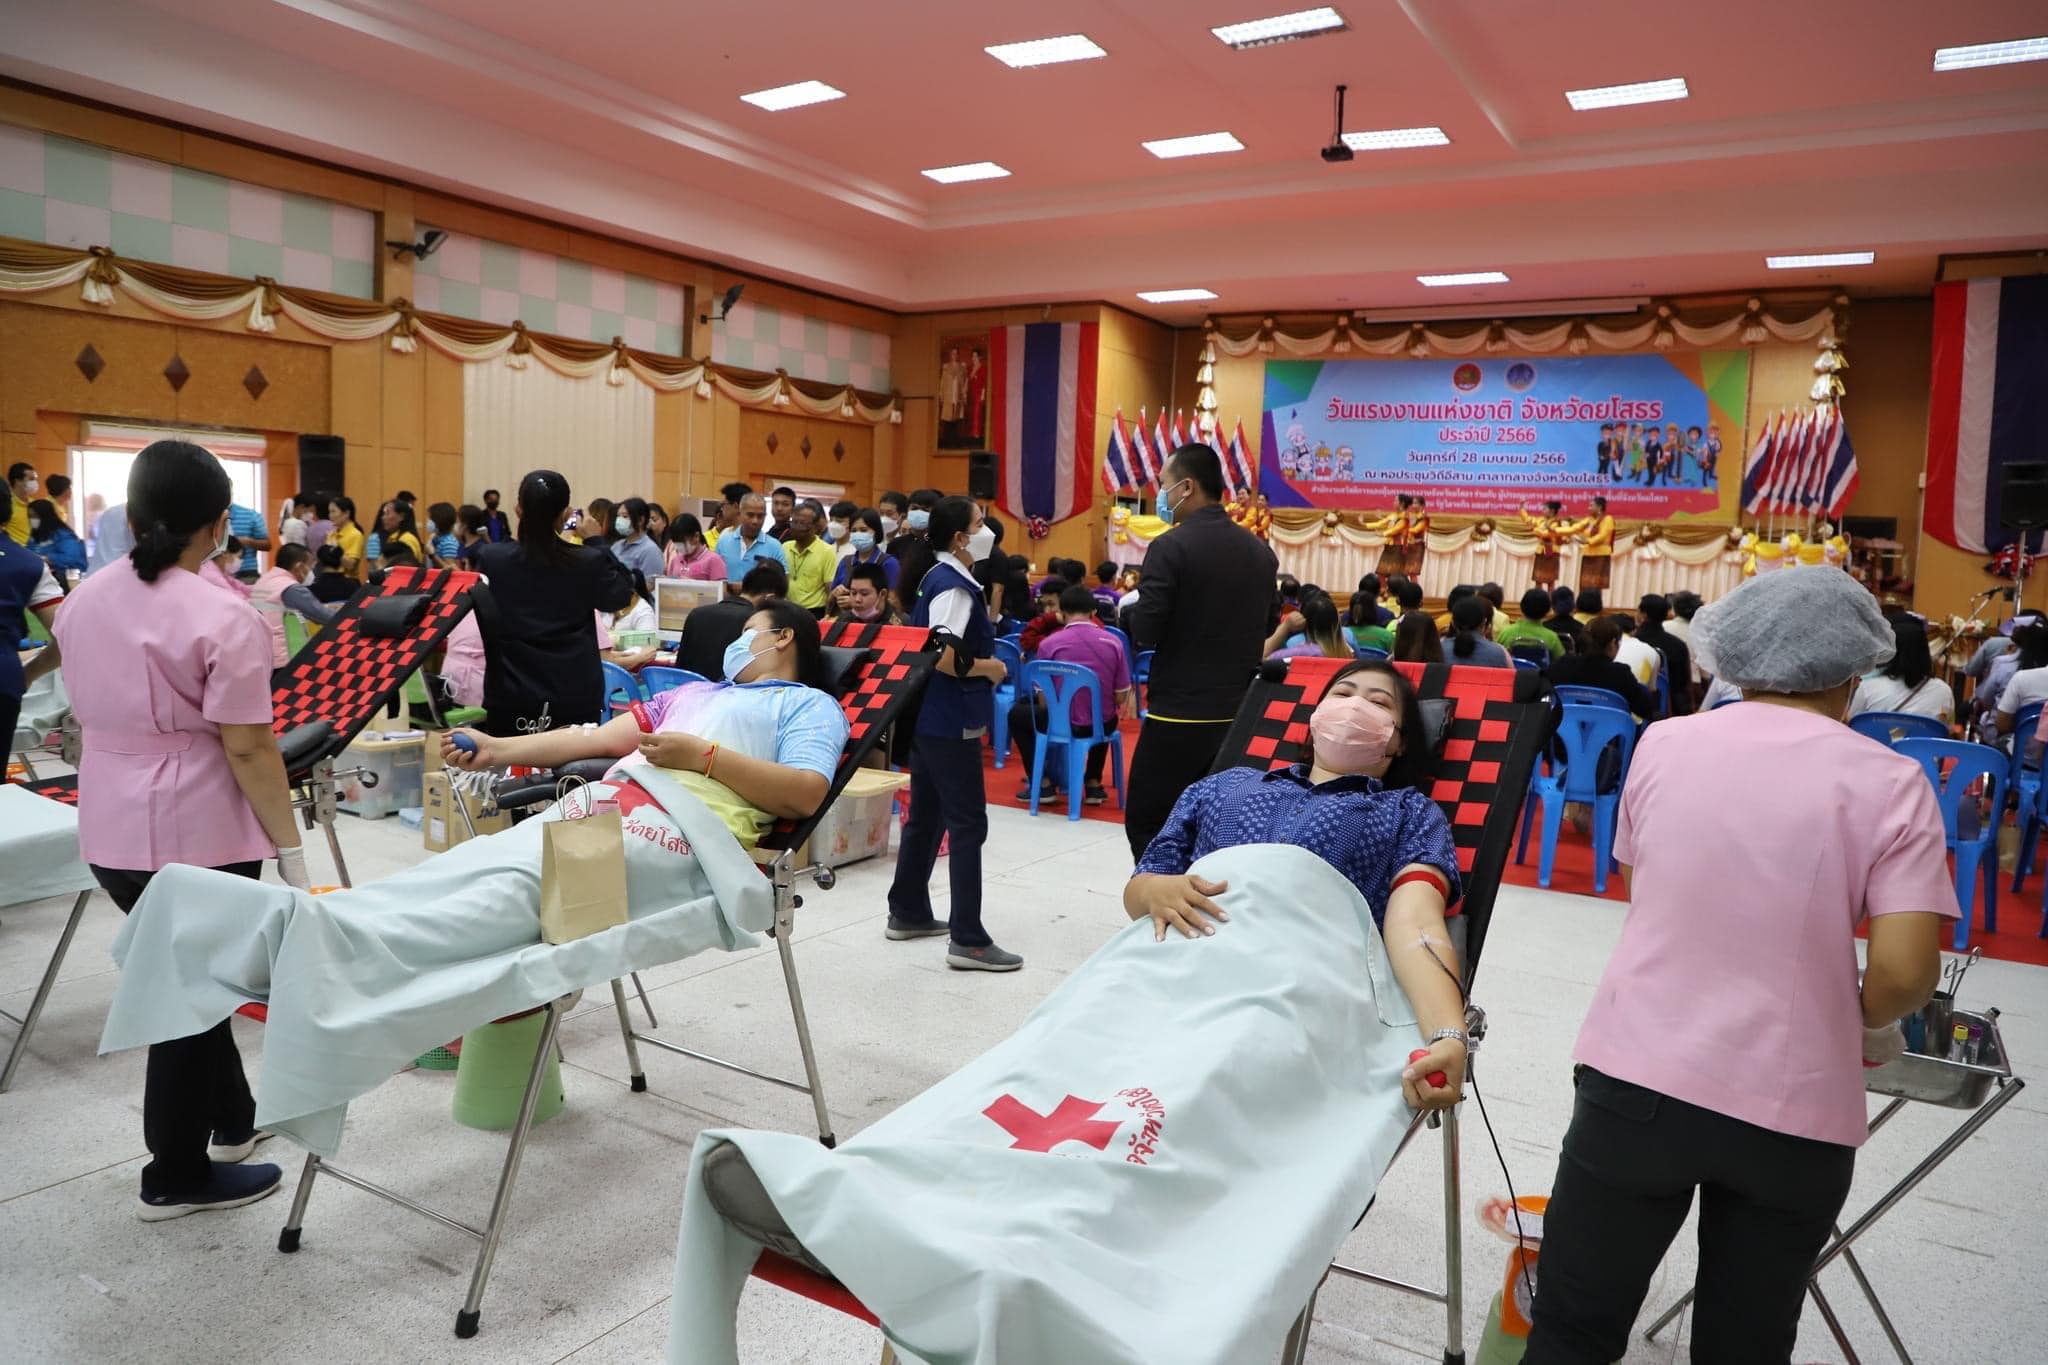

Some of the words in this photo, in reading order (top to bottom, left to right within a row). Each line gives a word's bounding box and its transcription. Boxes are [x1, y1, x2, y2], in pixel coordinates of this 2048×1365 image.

[1328, 397, 1512, 421] วันแรงงานแห่งชาติ
[1521, 396, 1663, 421] จังหวัดยโสธร
[1440, 426, 1490, 443] ประจำปี
[1496, 427, 1536, 443] 2566
[1408, 449, 1457, 465] วันศุกร์ที่
[1462, 452, 1477, 463] 28
[1482, 453, 1528, 464] เมษายน
[1533, 452, 1566, 464] 2566
